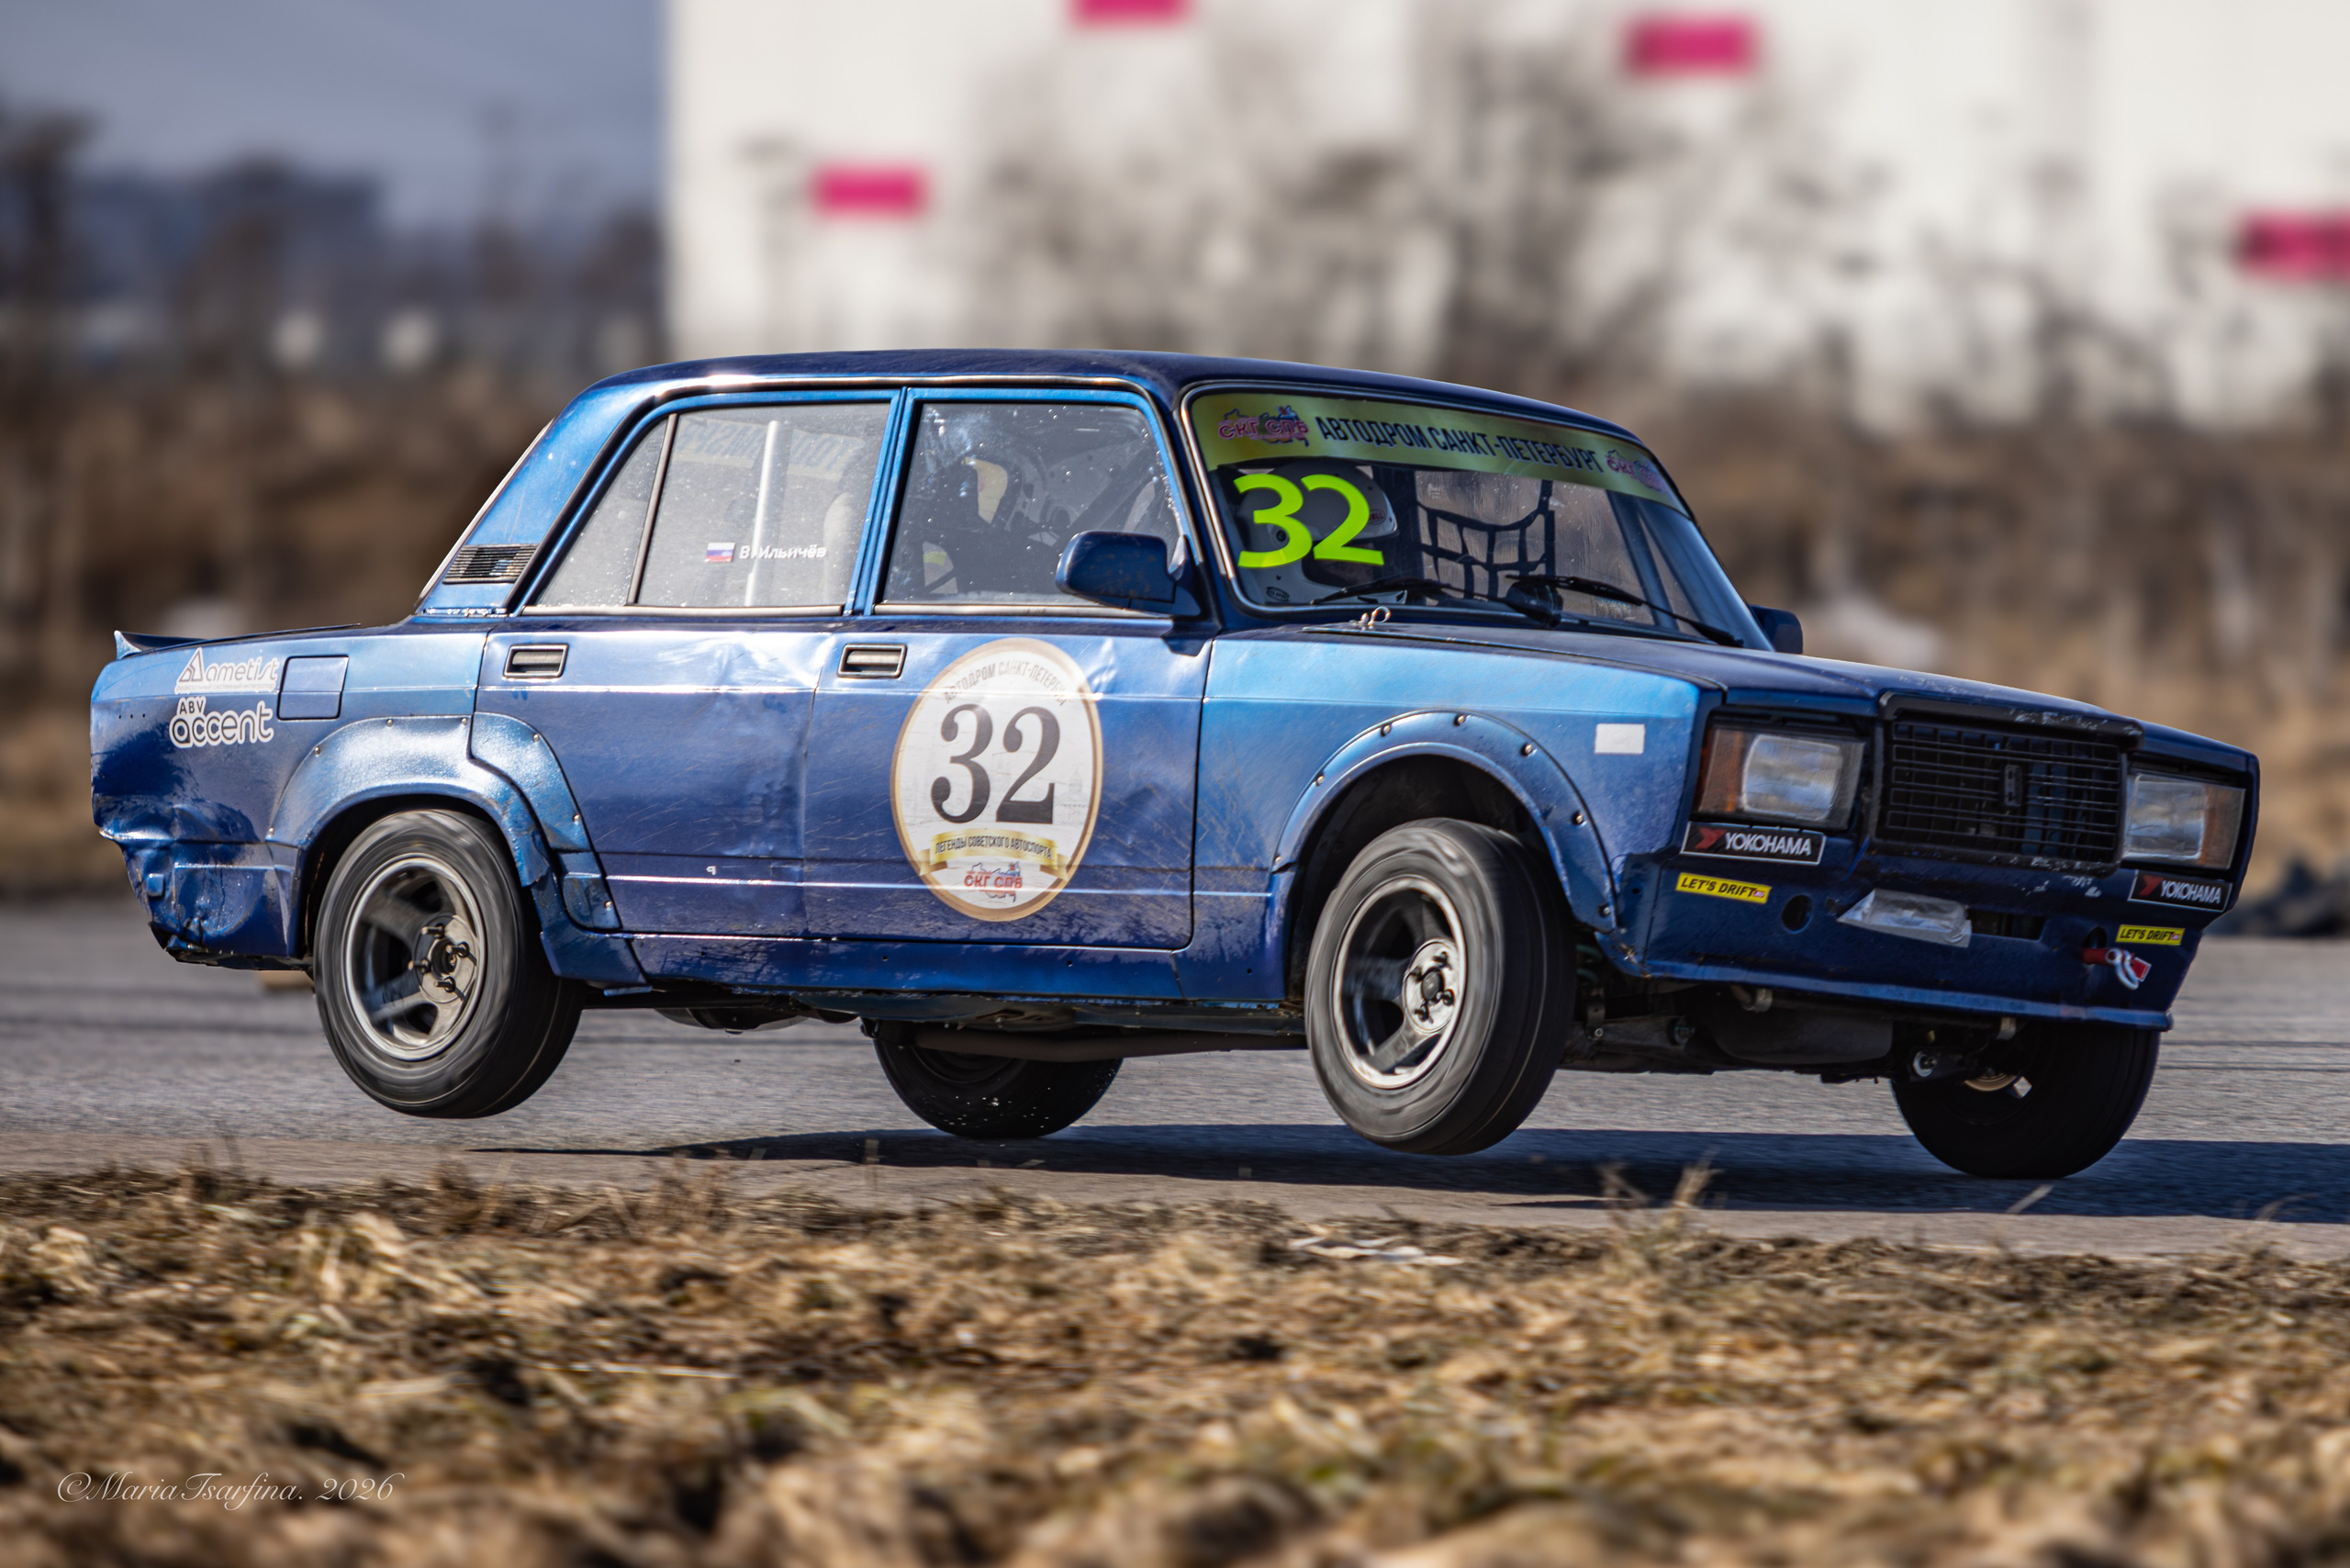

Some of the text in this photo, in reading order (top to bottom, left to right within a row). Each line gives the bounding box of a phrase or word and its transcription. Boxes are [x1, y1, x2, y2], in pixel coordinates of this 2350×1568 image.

[1315, 416, 1605, 473] АВТОДРОМ САНКТ-ПЕТЕРБУРГ
[1233, 473, 1384, 568] 32
[757, 543, 827, 559] Ильичёв
[179, 700, 205, 715] ABV
[172, 703, 274, 745] accent
[930, 703, 1060, 824] 32
[934, 835, 1053, 860] ЛЕГЕНДЫ СОВЕТСКОГО АВТОСПОРТА
[1725, 832, 1812, 857] YOKOHAMA
[964, 874, 1024, 890] СКГ СПБ
[1680, 876, 1717, 891] LET'S
[2160, 879, 2221, 904] YOKOHAMA
[2120, 928, 2145, 939] LET'S
